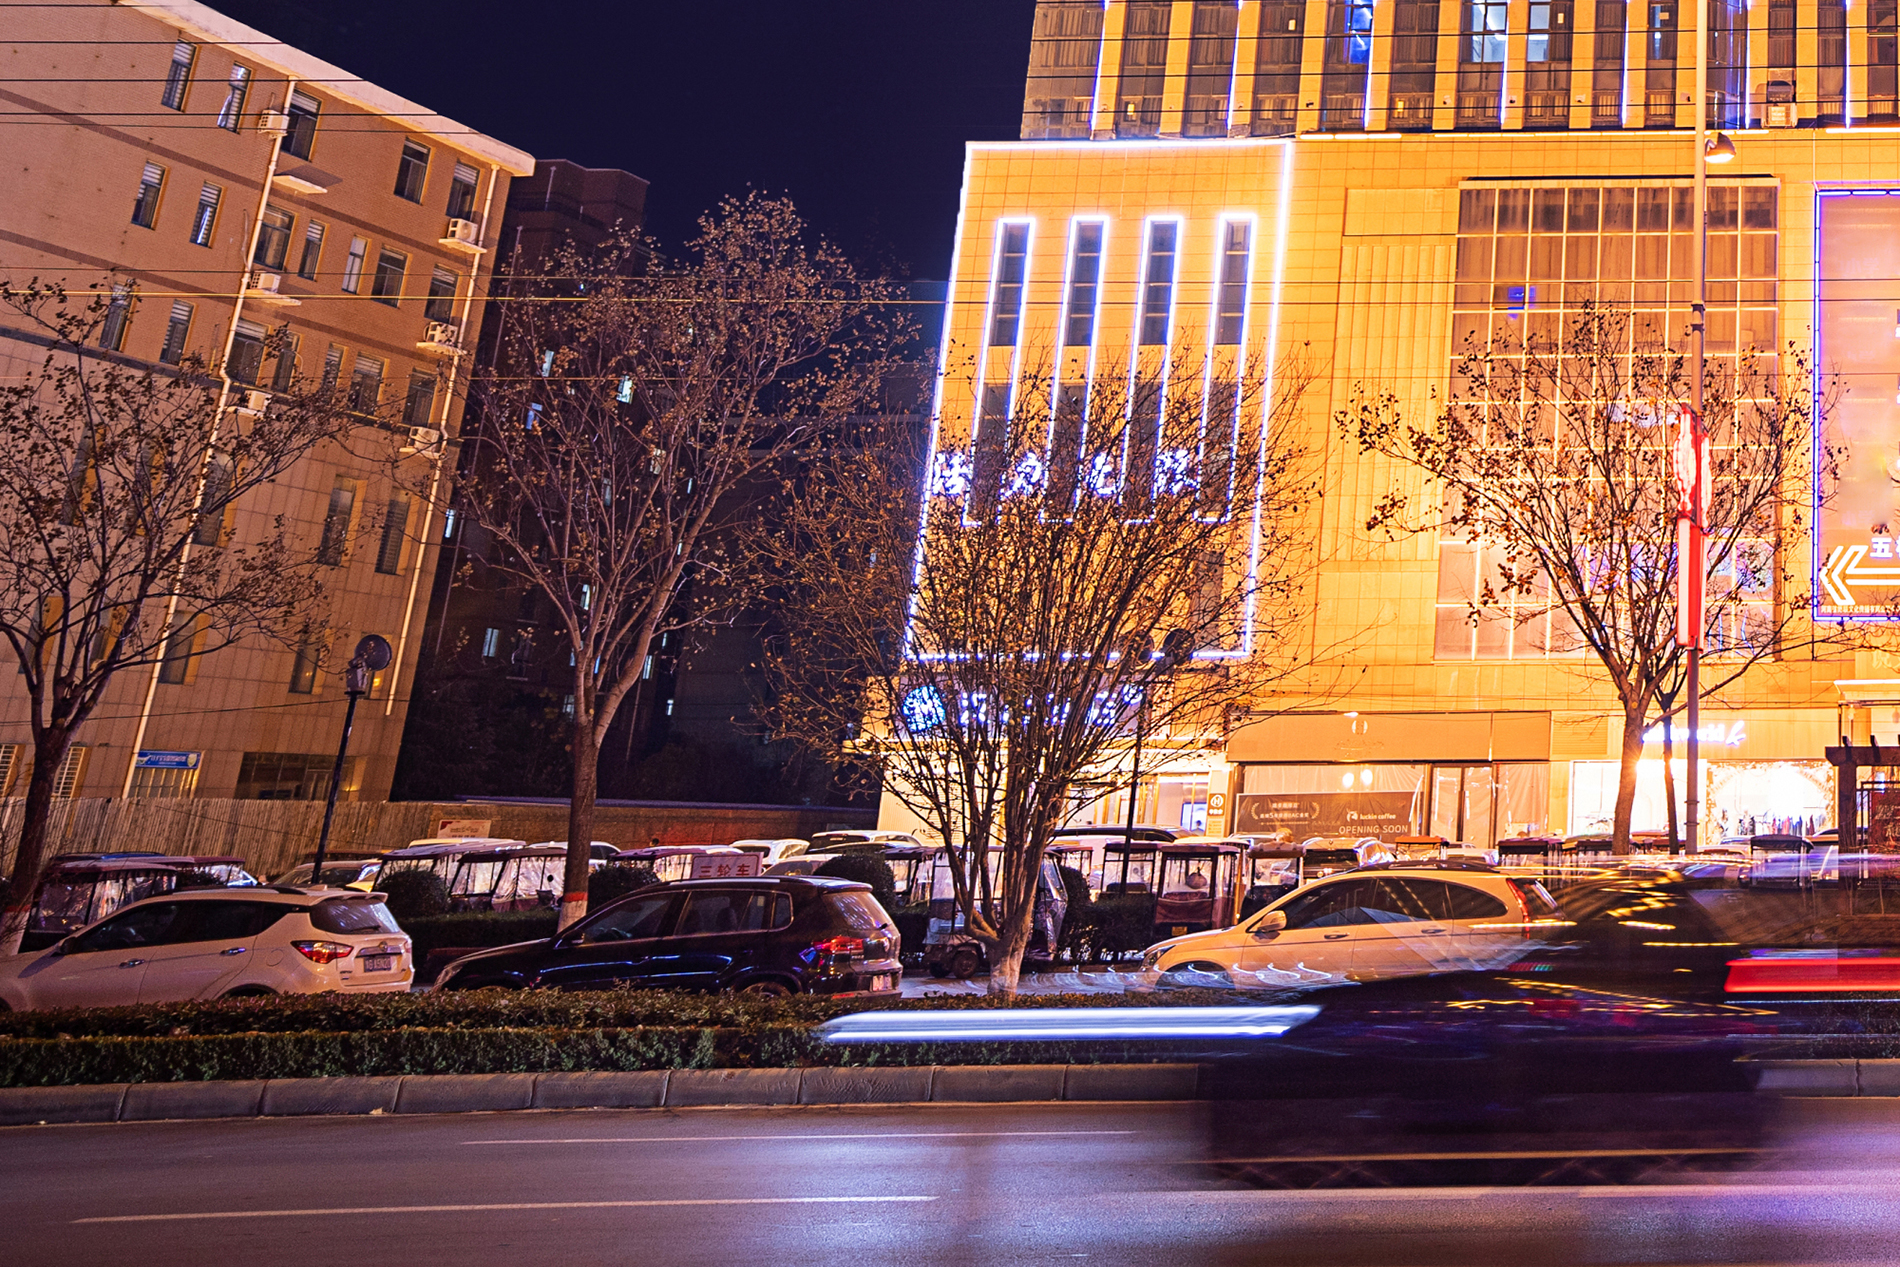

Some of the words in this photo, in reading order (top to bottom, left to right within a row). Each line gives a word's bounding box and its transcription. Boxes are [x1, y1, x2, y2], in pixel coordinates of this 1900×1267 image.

[1338, 825, 1380, 835] OPENING
[1382, 824, 1409, 834] SOON
[698, 863, 751, 879] 三轮车
